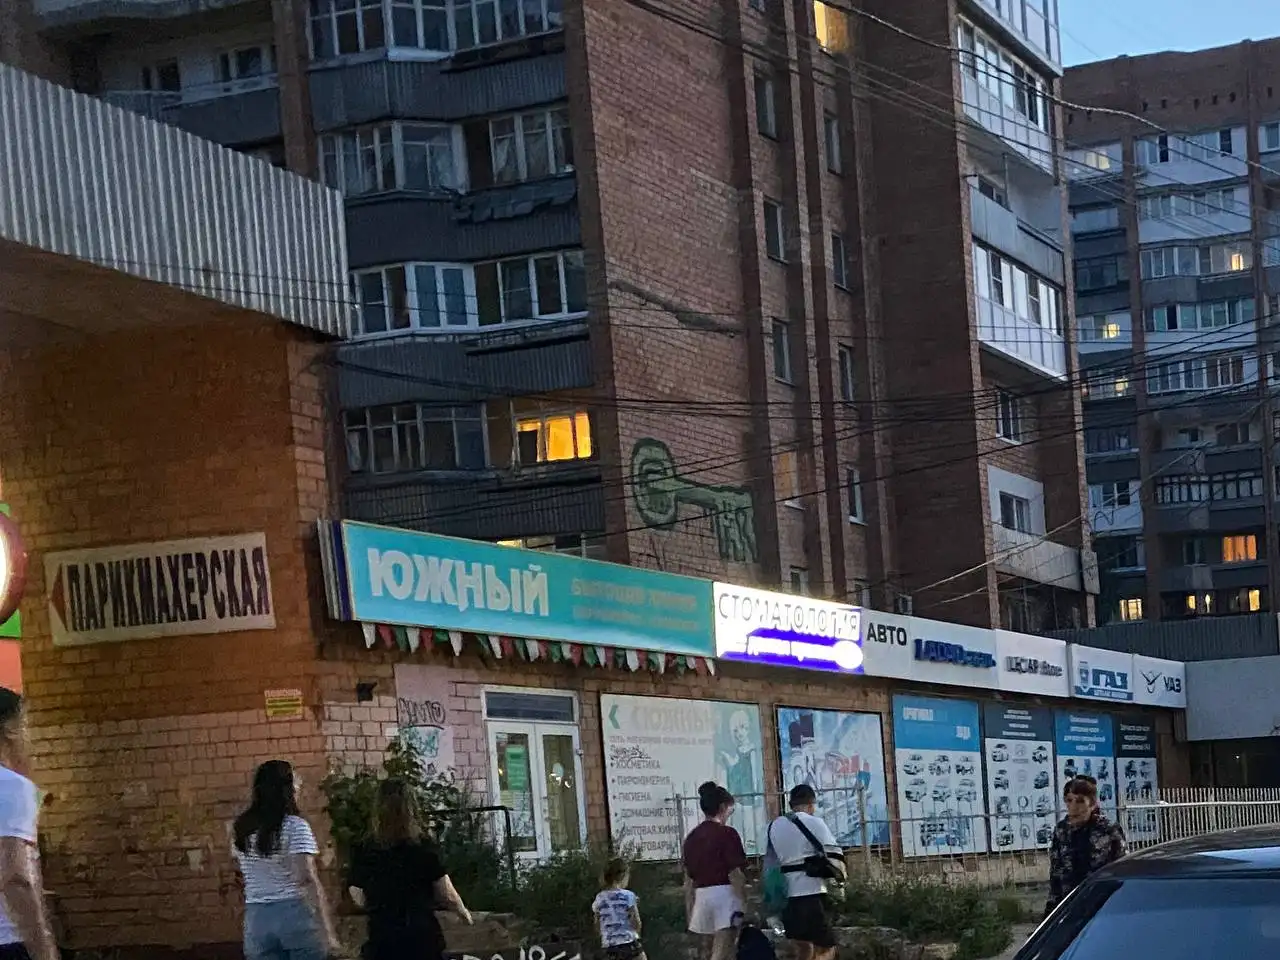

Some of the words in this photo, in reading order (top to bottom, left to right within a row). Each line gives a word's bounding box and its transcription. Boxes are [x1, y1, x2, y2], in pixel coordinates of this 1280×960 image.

[67, 546, 270, 631] ПАРИКМАХЕРСКАЯ
[367, 547, 550, 617] ЮЖНЫЙ
[867, 622, 908, 647] АВТО
[1092, 668, 1128, 690] ГАЗ
[1163, 675, 1182, 693] УАЗ
